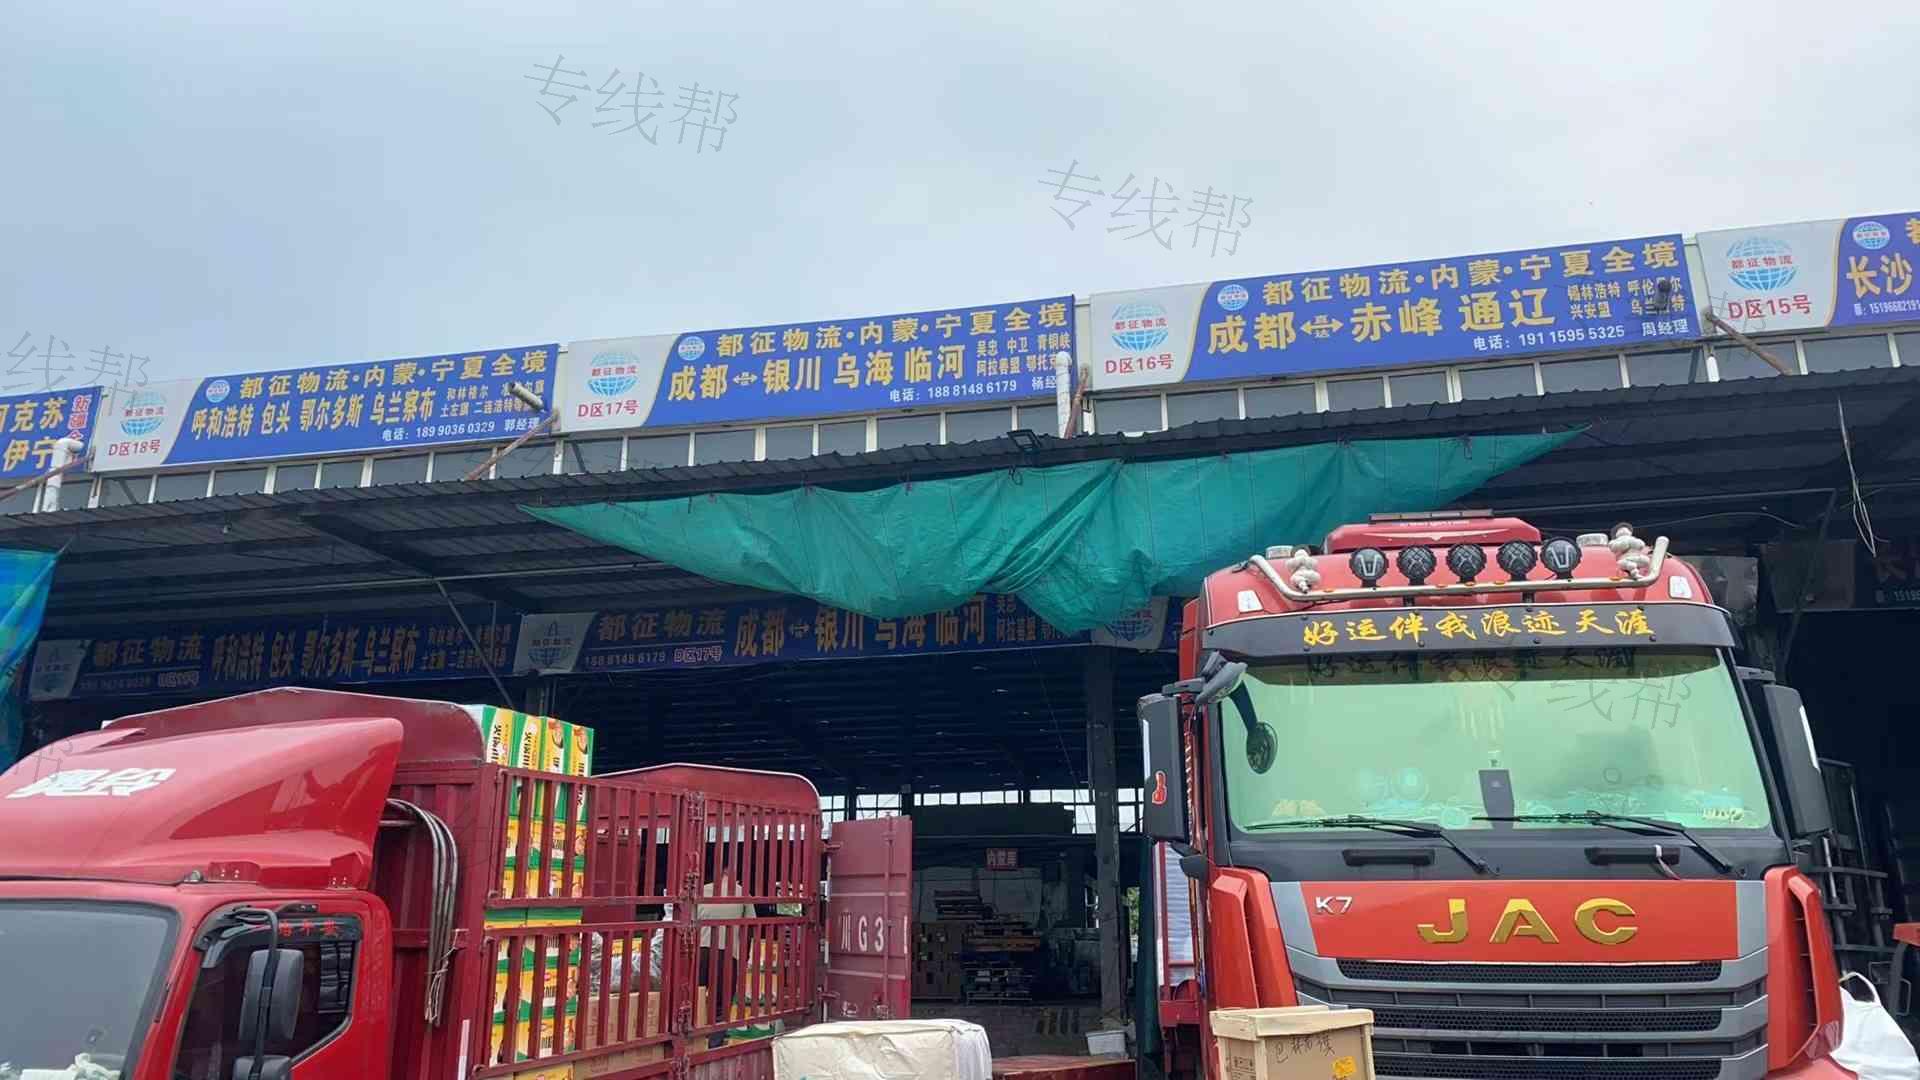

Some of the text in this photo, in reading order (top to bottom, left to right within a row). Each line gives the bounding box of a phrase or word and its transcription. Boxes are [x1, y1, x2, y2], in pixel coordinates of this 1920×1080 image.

[1846, 253, 1912, 298] 长沙
[1570, 301, 1612, 320] 兴安盟
[1728, 294, 1812, 319] D区15号
[1207, 288, 1556, 354] 成都 赤峰 通辽
[1518, 331, 1545, 347] 191
[1550, 328, 1585, 343] 1595
[1588, 325, 1625, 340] 5325
[1641, 318, 1689, 337] 周经理
[1007, 336, 1029, 353] 中卫
[668, 344, 966, 401] 成都 银川 乌海 临河
[1026, 353, 1058, 372] 鄂托克
[1105, 353, 1174, 374] D区16号
[927, 386, 950, 399] 188
[953, 383, 983, 397] 8148
[986, 379, 1017, 394] 6179
[1031, 376, 1057, 391] 杨经
[191, 387, 437, 441] 呼和浩特 包头 鄂尔多斯 乌兰察布
[578, 399, 640, 418] D区17号
[415, 426, 436, 439] 189
[437, 424, 466, 437] 9036
[469, 421, 496, 433] 0329
[108, 439, 161, 457] D区18号
[599, 608, 725, 640] 都征物流
[734, 607, 785, 657] 成都
[815, 606, 865, 653] 银川
[1303, 610, 1655, 647] 好运伴我浪迹天涯
[1315, 896, 1353, 915] K7
[1416, 898, 1638, 945] JAC
